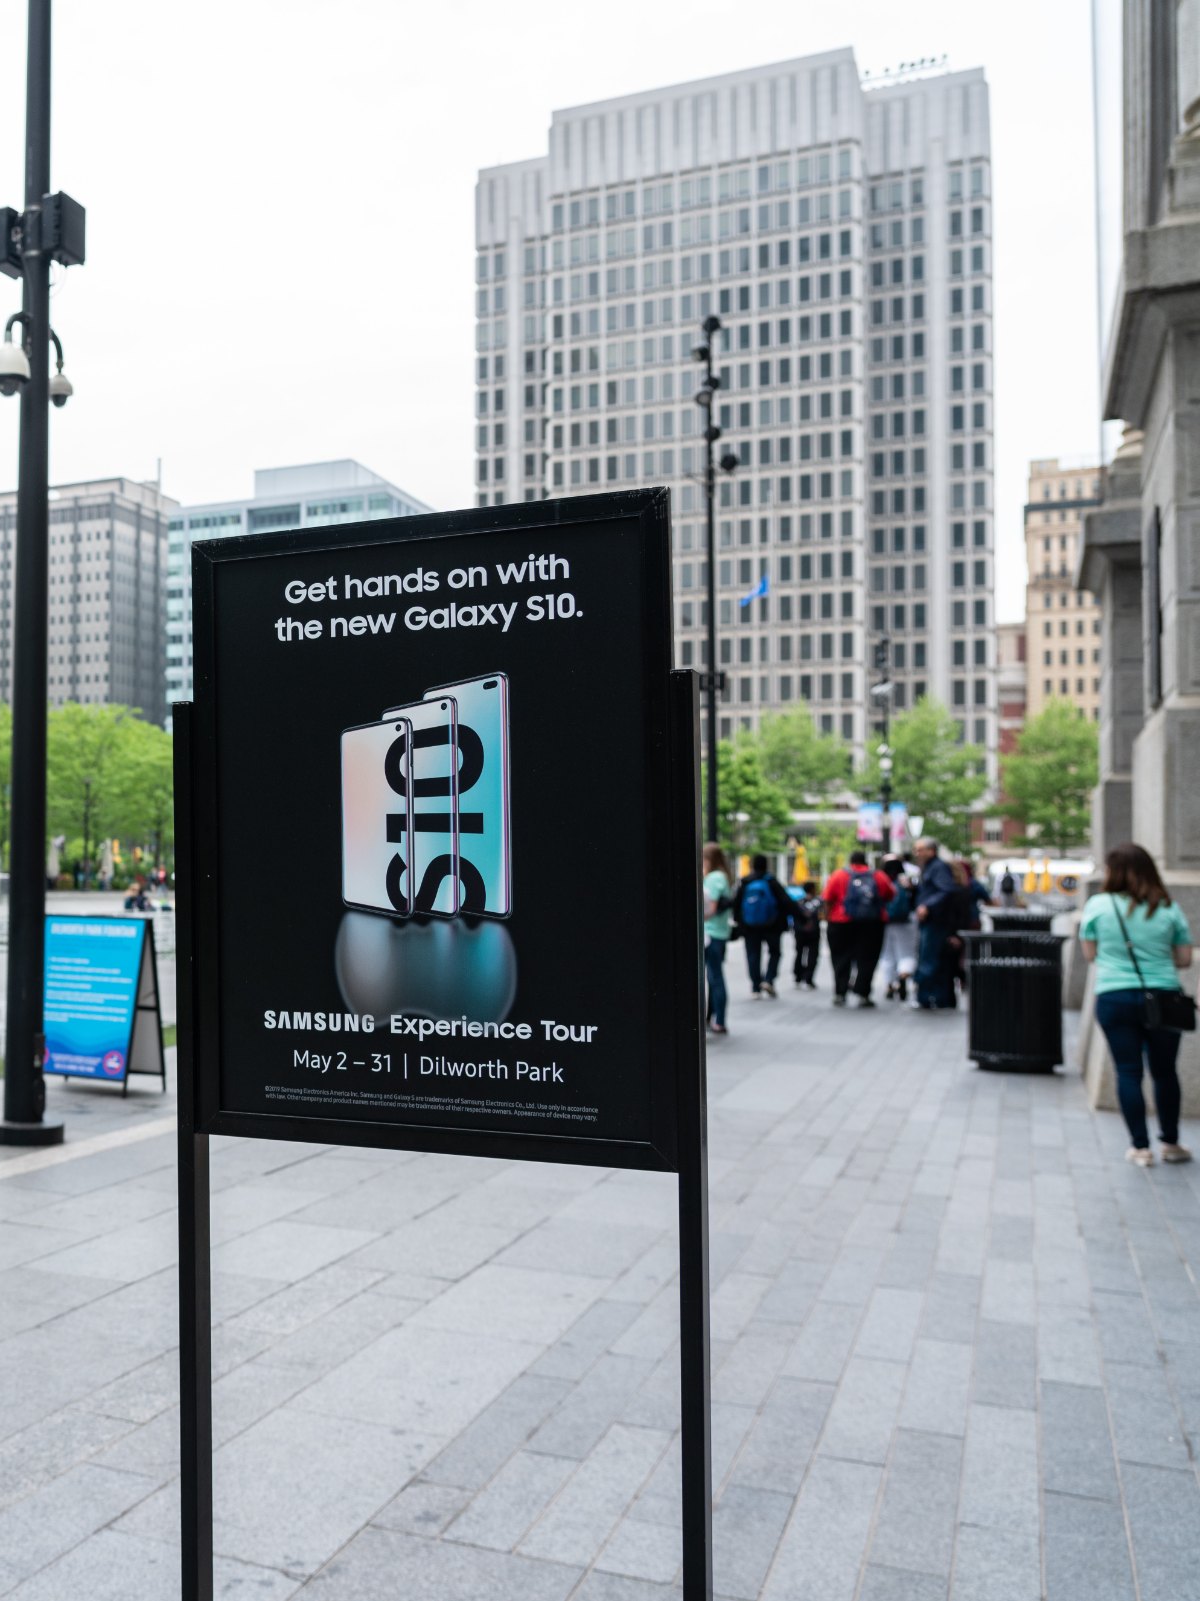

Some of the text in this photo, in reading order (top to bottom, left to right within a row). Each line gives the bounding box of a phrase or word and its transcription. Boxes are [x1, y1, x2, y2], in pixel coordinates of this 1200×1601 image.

[284, 553, 570, 604] Get hands on with
[274, 592, 584, 642] the new Galaxy S10.
[384, 723, 487, 912] S10
[263, 1009, 598, 1043] SAMSUNG Experience Tour
[292, 1049, 332, 1073] May
[336, 1051, 348, 1071] 2
[370, 1053, 392, 1073] 31
[419, 1056, 509, 1080] Dilworth
[516, 1060, 564, 1083] Park
[464, 1106, 491, 1114] respective
[513, 1110, 545, 1118] Appearance
[485, 1100, 515, 1108] Electronics
[548, 1104, 561, 1112] only
[567, 1106, 599, 1114] accordance
